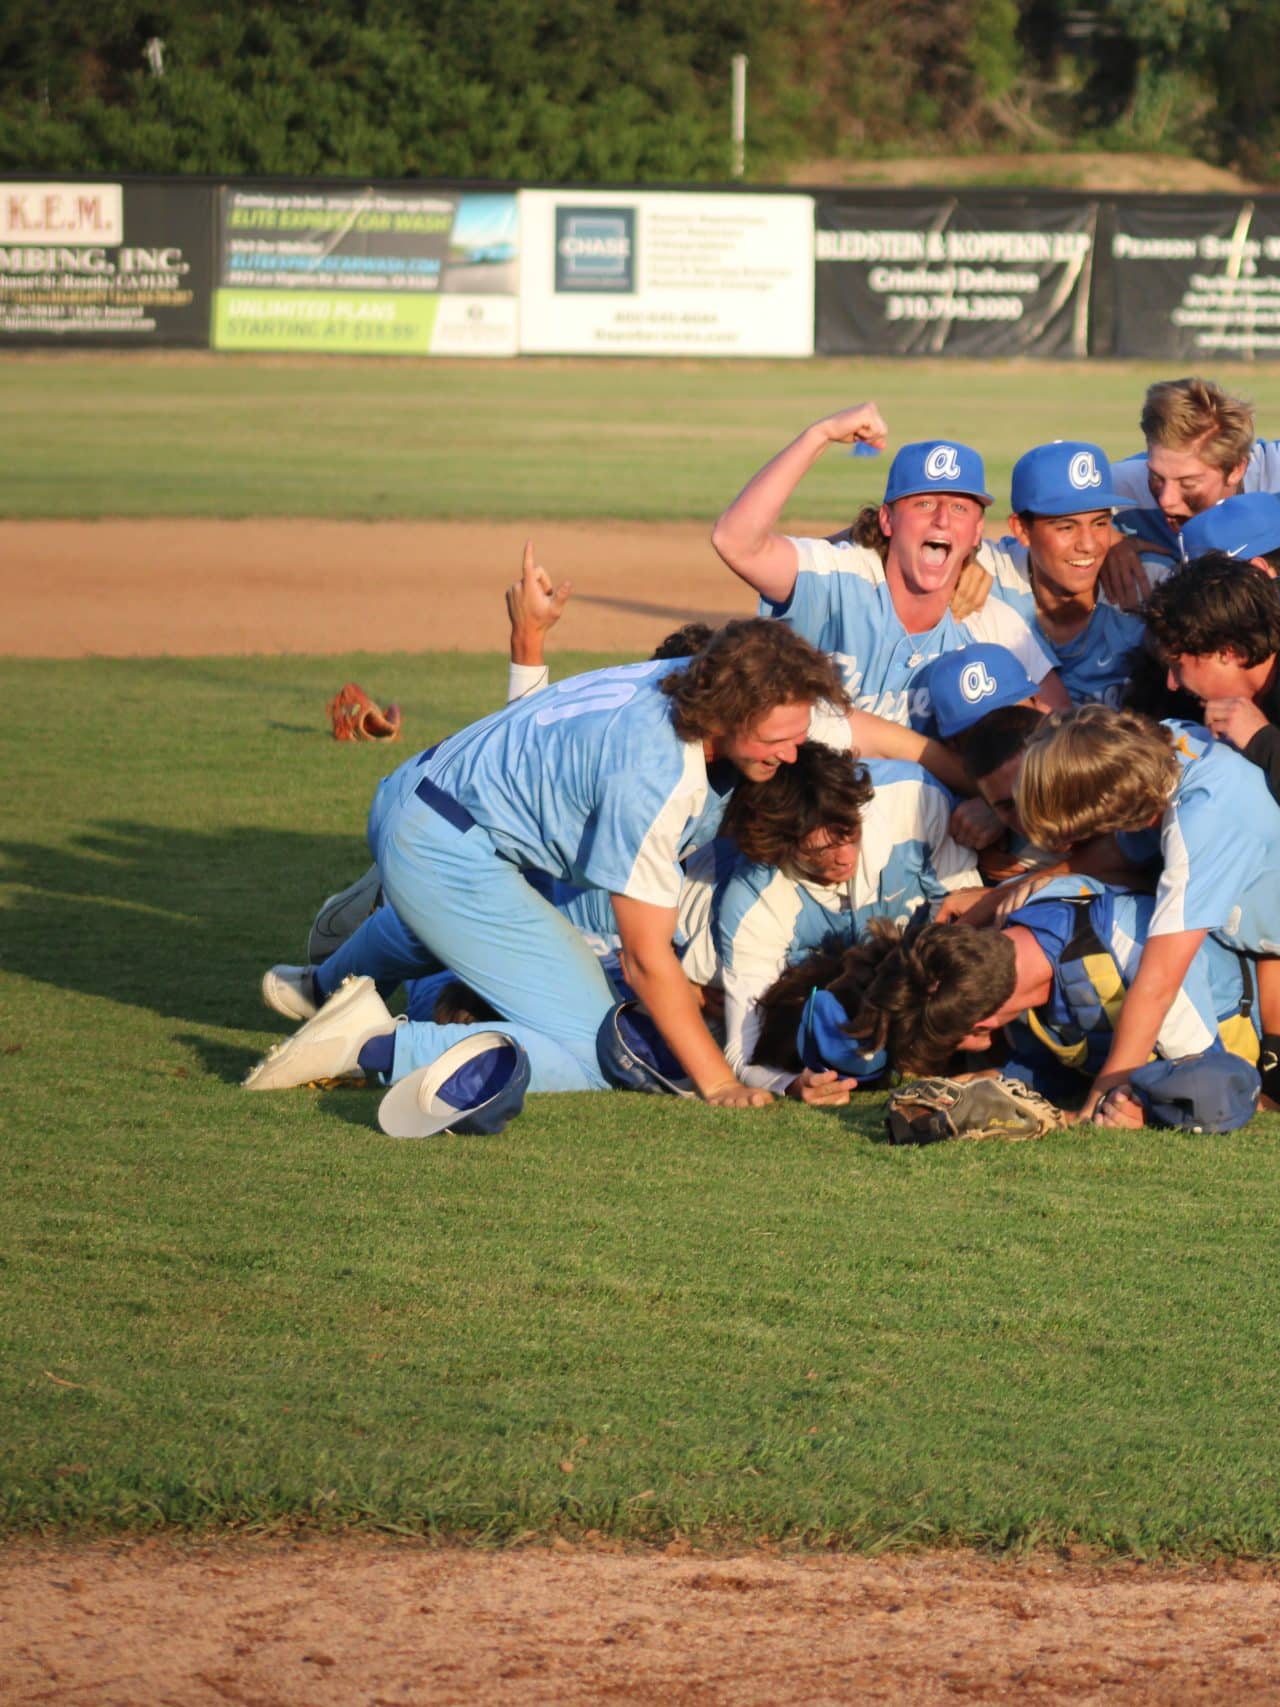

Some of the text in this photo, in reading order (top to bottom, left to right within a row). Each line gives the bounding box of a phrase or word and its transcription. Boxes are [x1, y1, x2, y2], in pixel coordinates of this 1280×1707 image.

[9, 196, 113, 231] K.E.M.
[231, 209, 276, 229] ELITE
[356, 212, 391, 232] CAR
[394, 214, 451, 233] WASH
[559, 236, 631, 256] CHASE
[815, 229, 924, 261] BLEDSTEIN
[926, 231, 946, 260] &
[119, 248, 190, 274] INC.
[868, 267, 1040, 293] Criminal Defense
[229, 299, 396, 321] UNLIMITED PLANS
[227, 319, 315, 337] STARTING
[324, 322, 349, 338] AT
